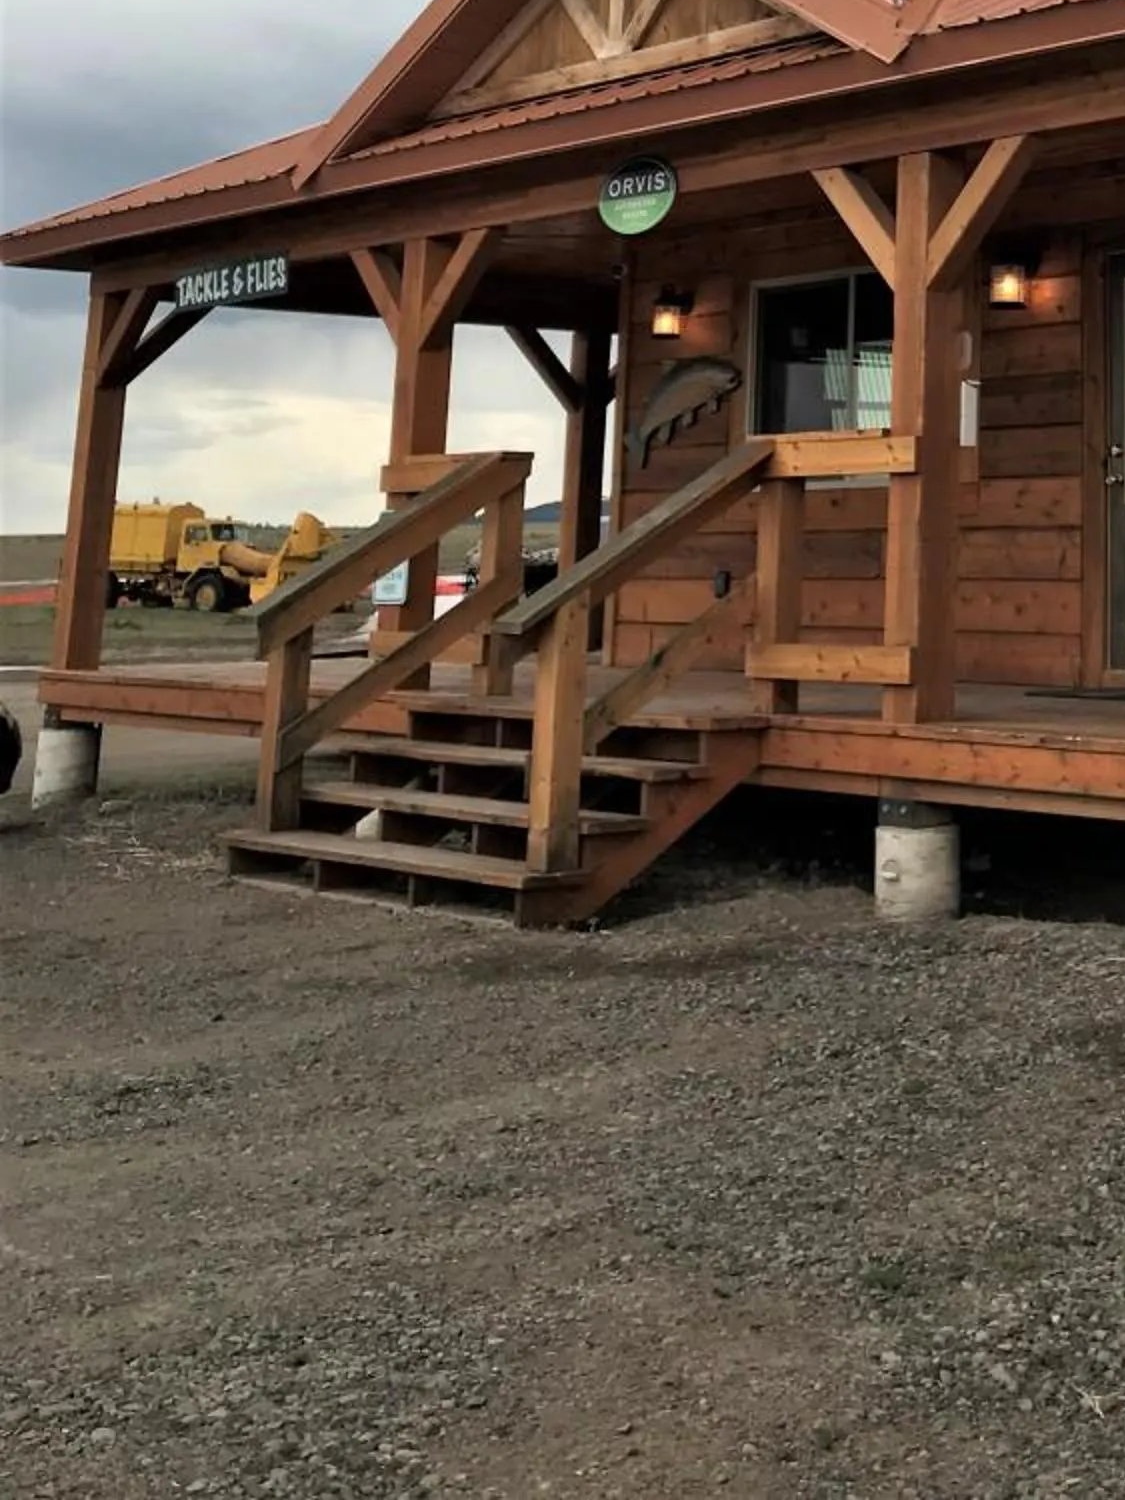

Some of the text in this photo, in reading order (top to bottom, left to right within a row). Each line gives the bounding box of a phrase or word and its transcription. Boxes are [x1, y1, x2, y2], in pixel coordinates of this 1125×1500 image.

[608, 171, 665, 198] ORVIS
[176, 257, 287, 307] TACKLE & FLIES
